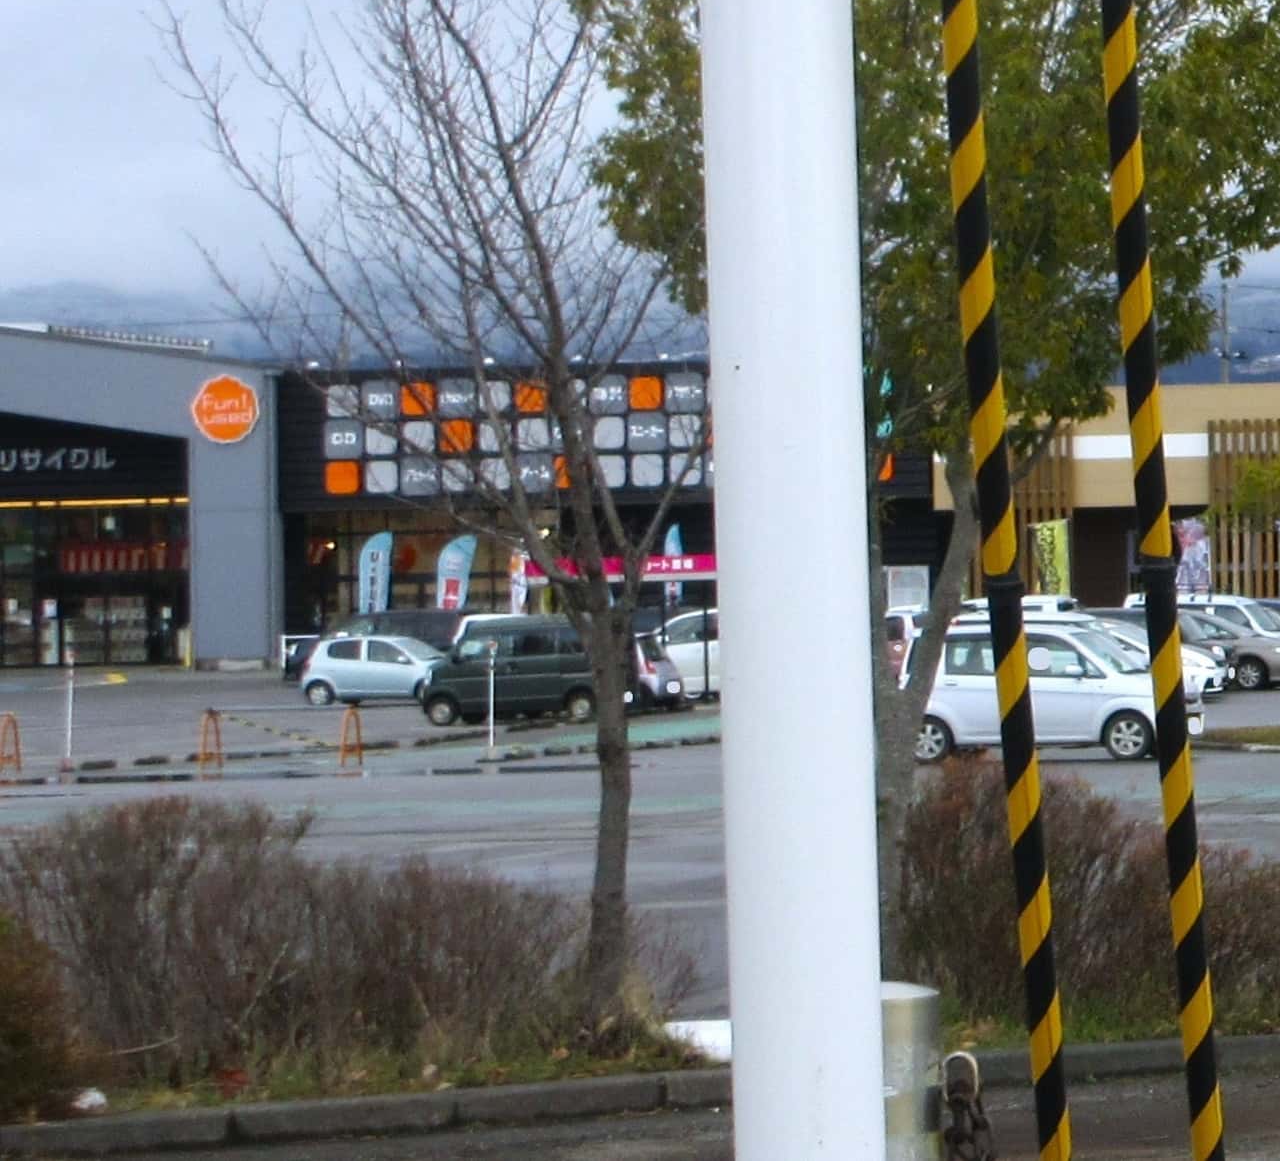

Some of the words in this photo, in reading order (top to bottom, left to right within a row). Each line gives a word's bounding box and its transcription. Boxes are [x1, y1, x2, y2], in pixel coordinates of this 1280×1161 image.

[0, 447, 116, 471] リサイクル
